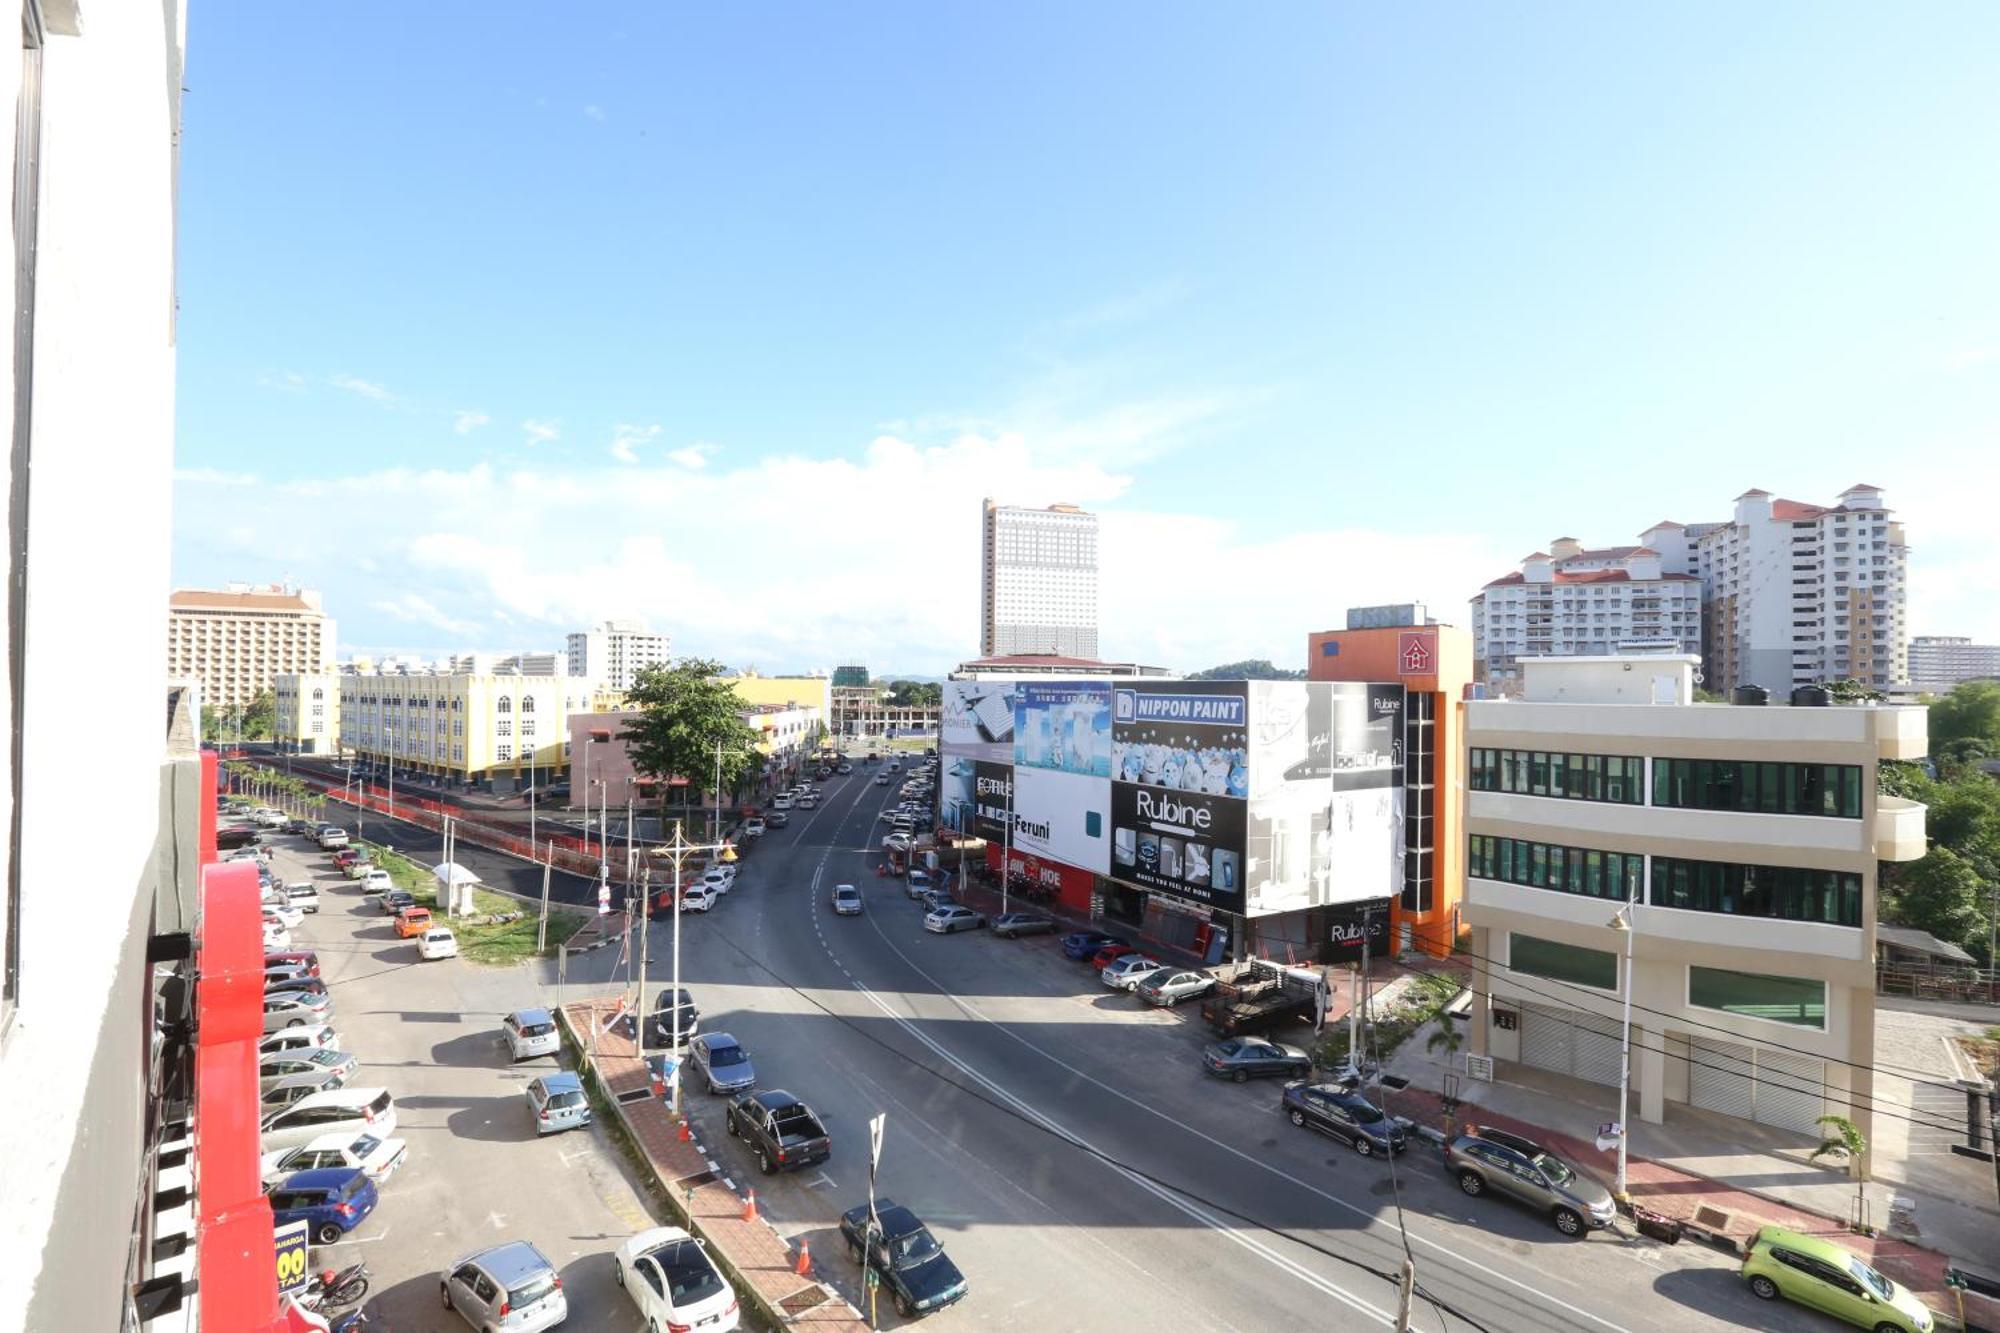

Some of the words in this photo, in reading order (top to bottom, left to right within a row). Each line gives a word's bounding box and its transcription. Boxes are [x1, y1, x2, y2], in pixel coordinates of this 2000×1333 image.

[1138, 699, 1190, 718] NIPPON
[1192, 700, 1240, 719] PAINT
[1373, 697, 1401, 710] Rubine
[1136, 790, 1212, 829] Rubine
[1014, 813, 1049, 840] Feruni
[1040, 867, 1060, 886] HOE
[1168, 880, 1182, 890] FEEL
